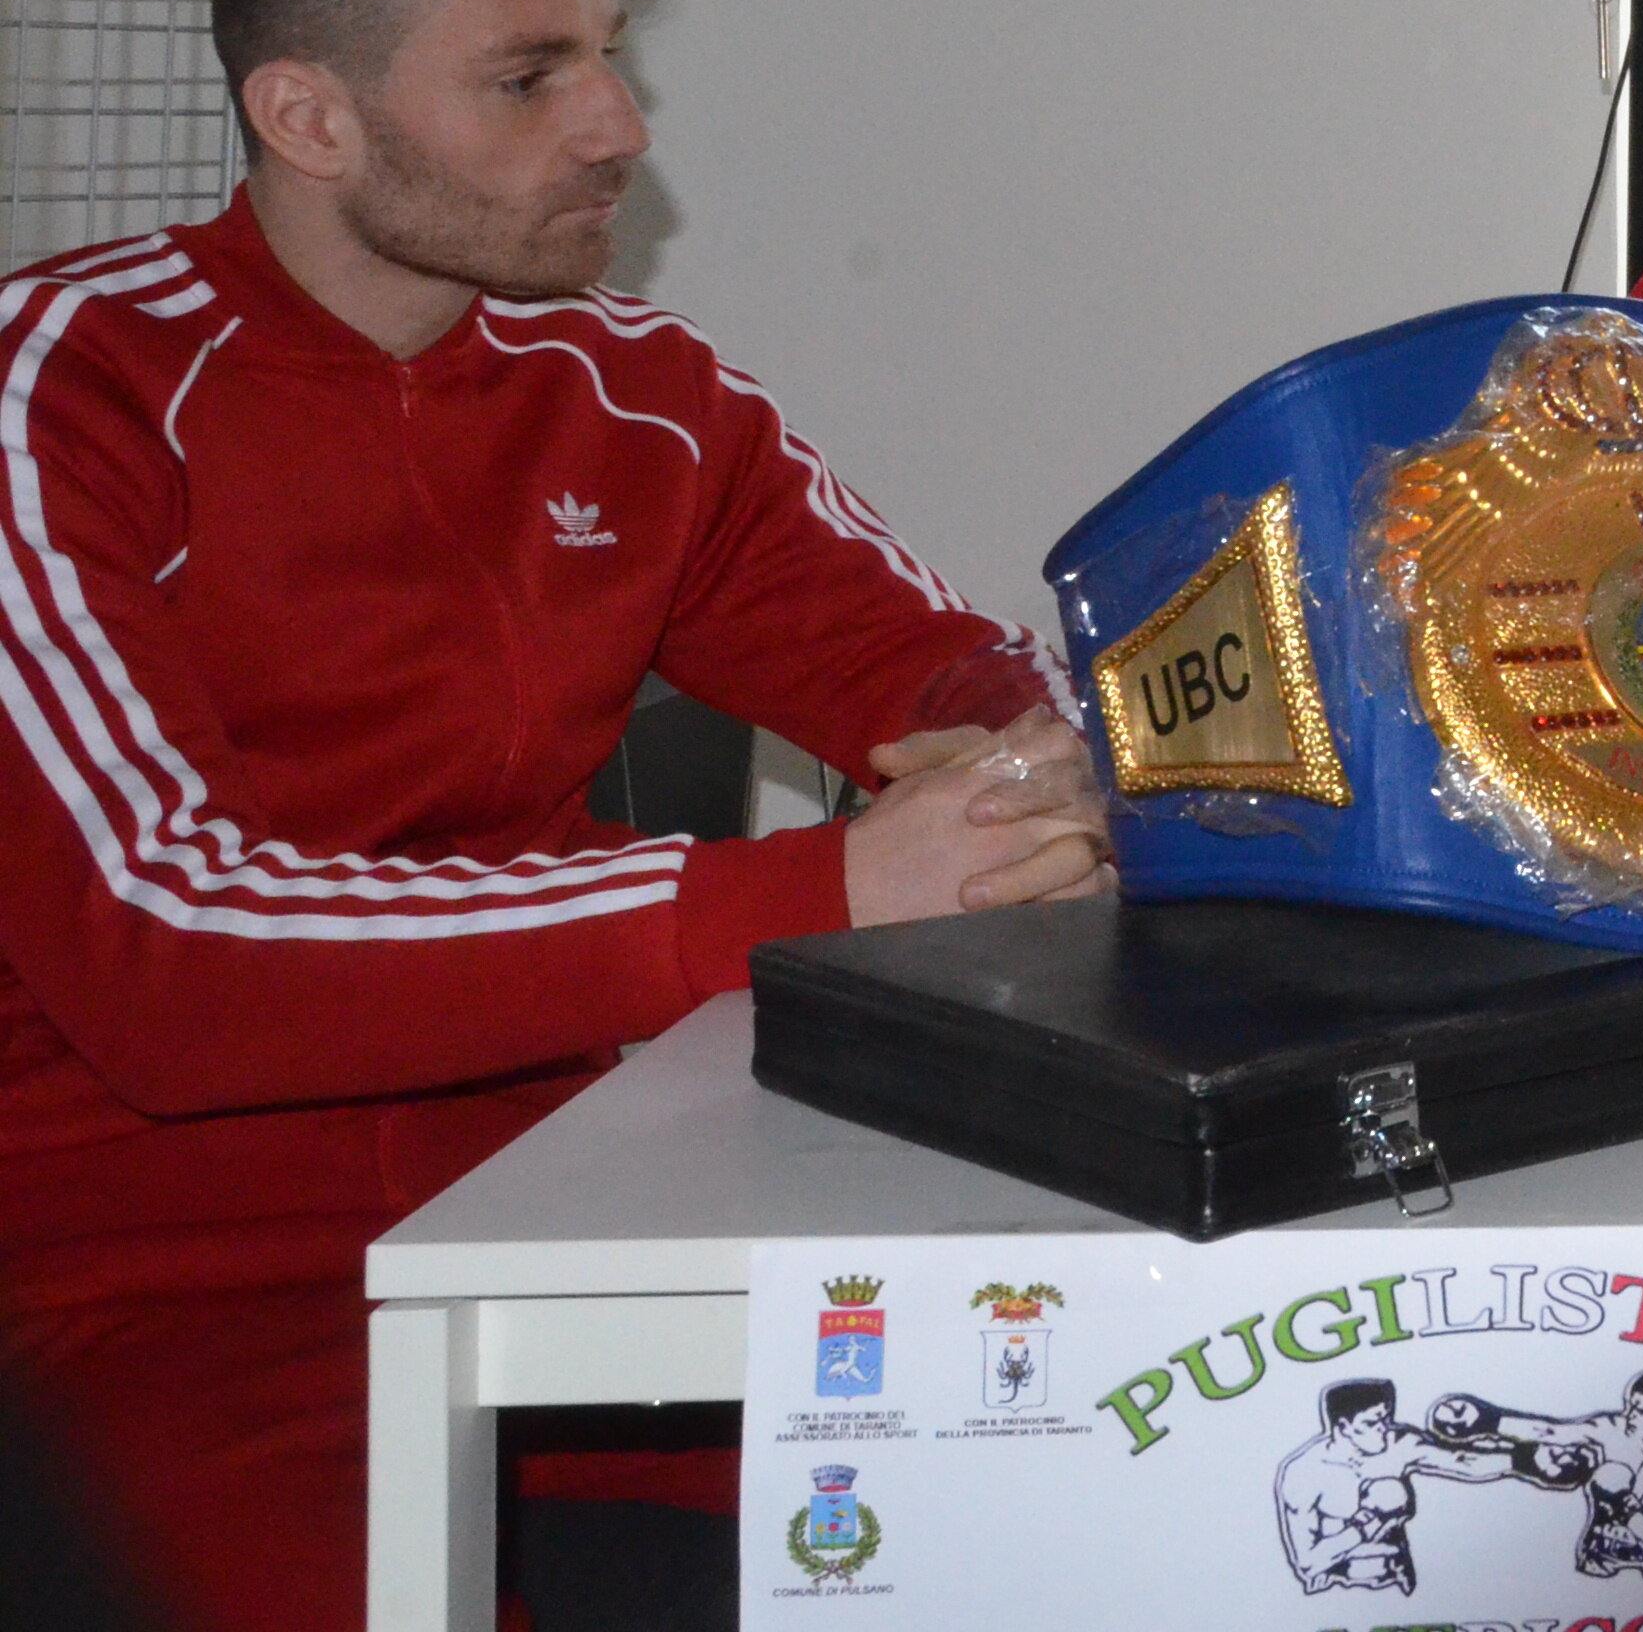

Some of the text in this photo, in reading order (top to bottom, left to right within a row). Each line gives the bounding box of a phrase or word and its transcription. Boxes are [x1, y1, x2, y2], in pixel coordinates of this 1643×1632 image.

[554, 530, 618, 547] adidas
[1140, 632, 1251, 737] UBC
[787, 1413, 810, 1422] CON
[824, 1411, 885, 1421] PATROCINIO
[964, 1419, 988, 1427] CON
[1002, 1416, 1065, 1426] PATROCINIO
[793, 1421, 901, 1432] COMUNE DI TARANTO
[936, 1425, 1092, 1439] DELLA PROVINCIA DI TARANTO
[775, 1429, 918, 1442] ASSESSORATO ALLO SPORT
[773, 1583, 894, 1597] COMUNE DI PULSANO
